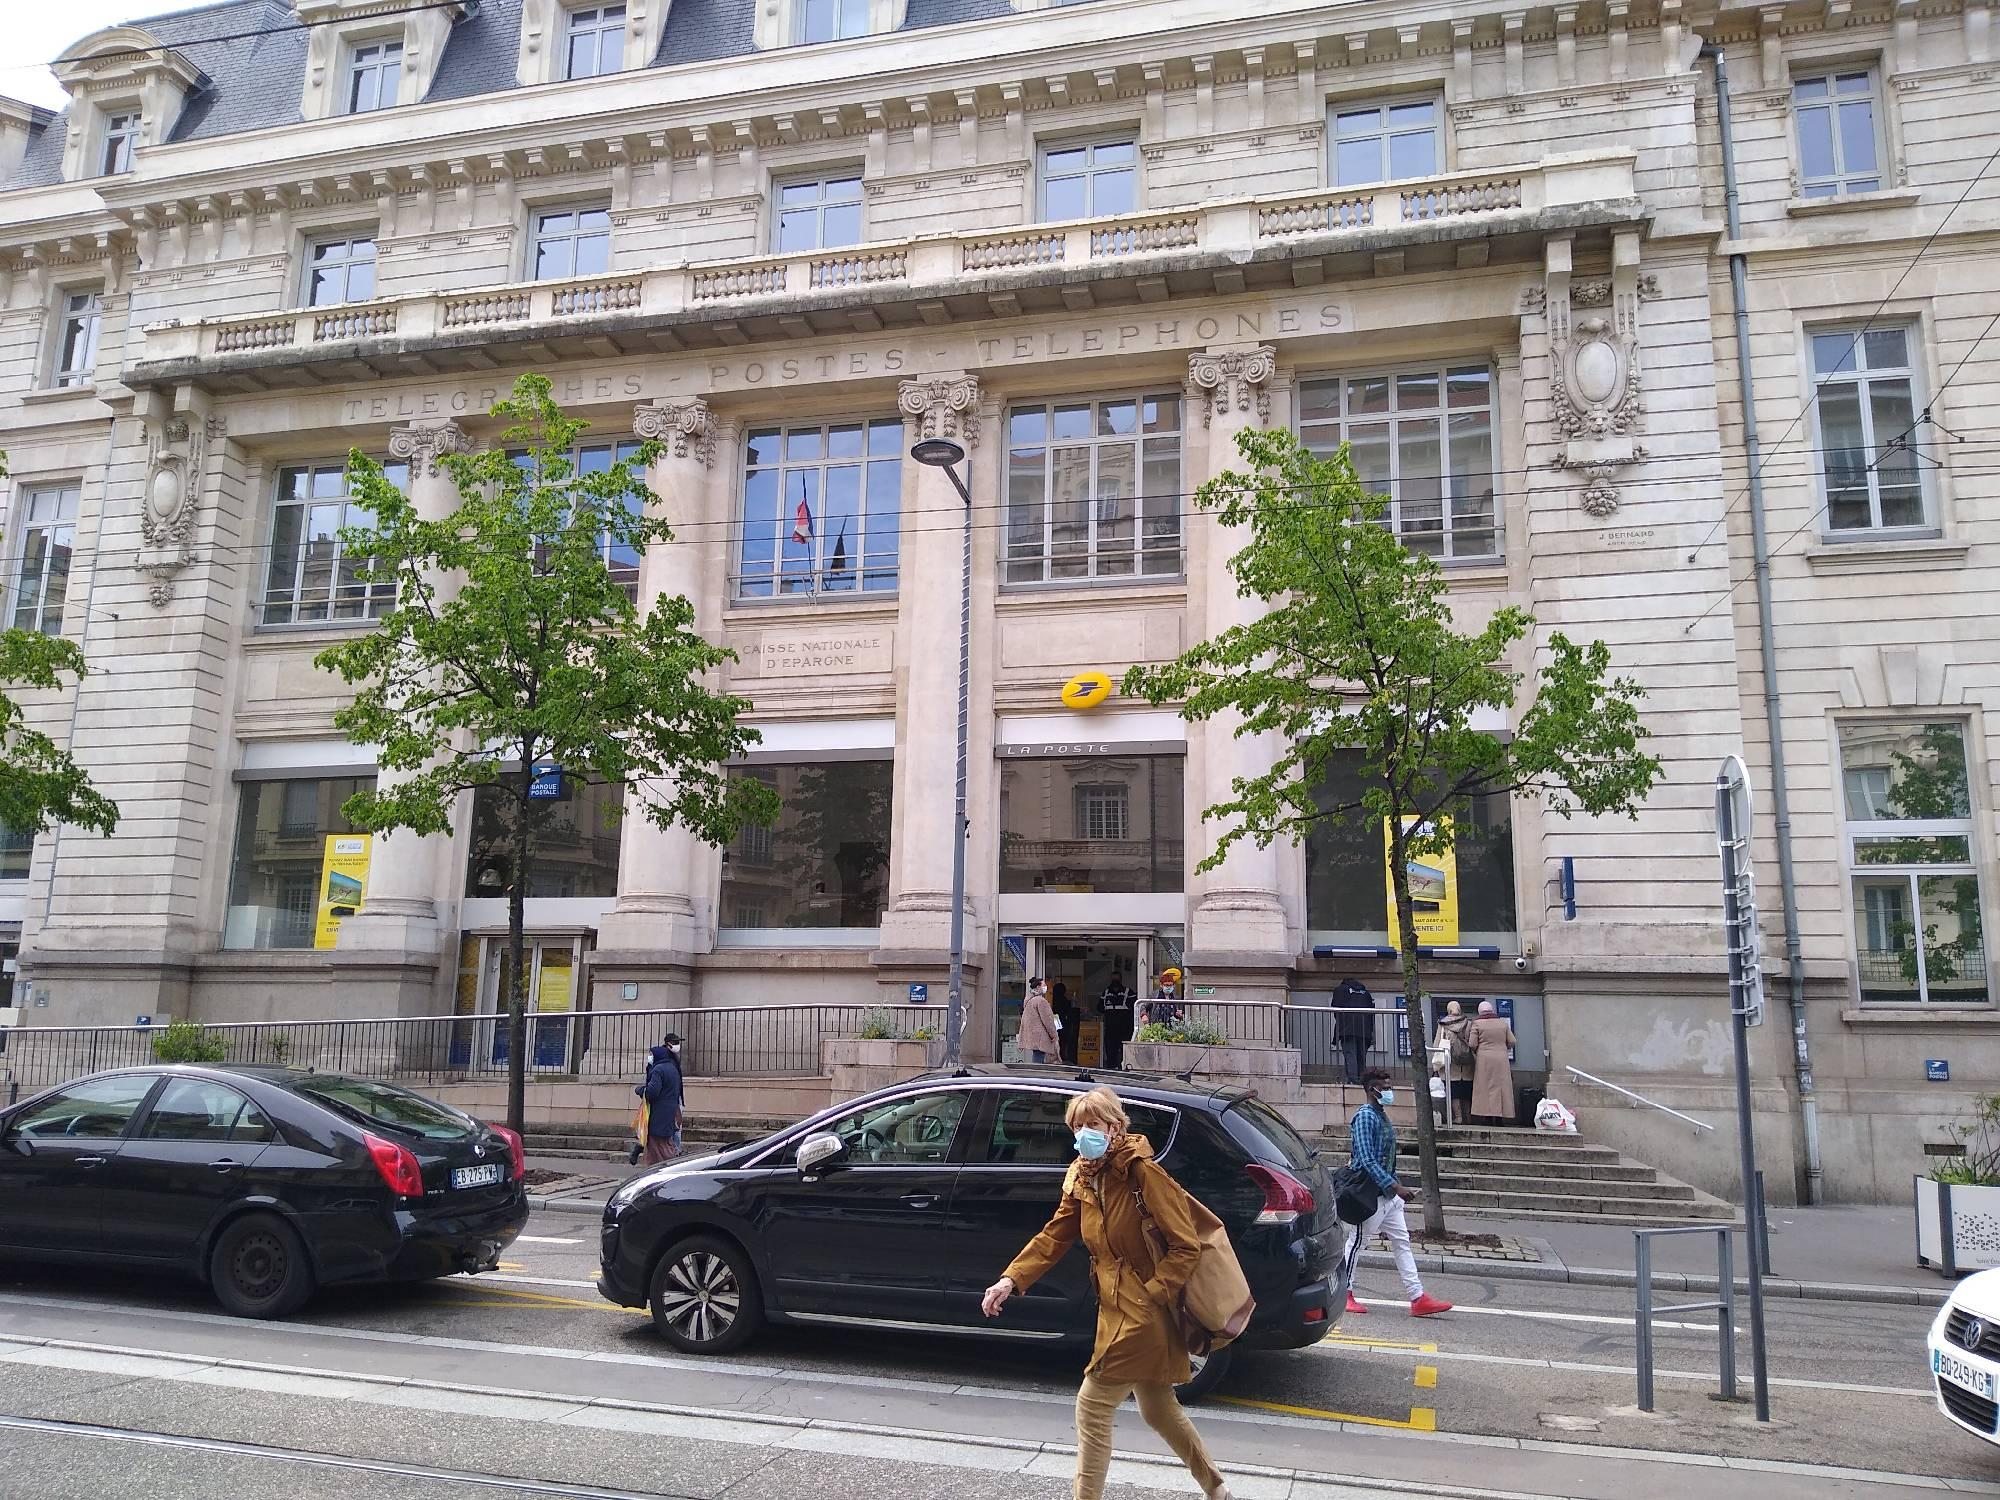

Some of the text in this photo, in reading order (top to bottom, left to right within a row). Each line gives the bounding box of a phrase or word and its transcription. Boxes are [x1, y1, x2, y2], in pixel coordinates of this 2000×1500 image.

[344, 374, 642, 420] TELEGRHES
[710, 348, 904, 388] POSTES
[978, 304, 1343, 363] TELEPHONES
[1608, 530, 1655, 540] BERNARD
[742, 639, 881, 655] CAISSE NATIONALE
[766, 655, 854, 669] D'EPARGNE
[1007, 744, 1110, 755] LA POSTE
